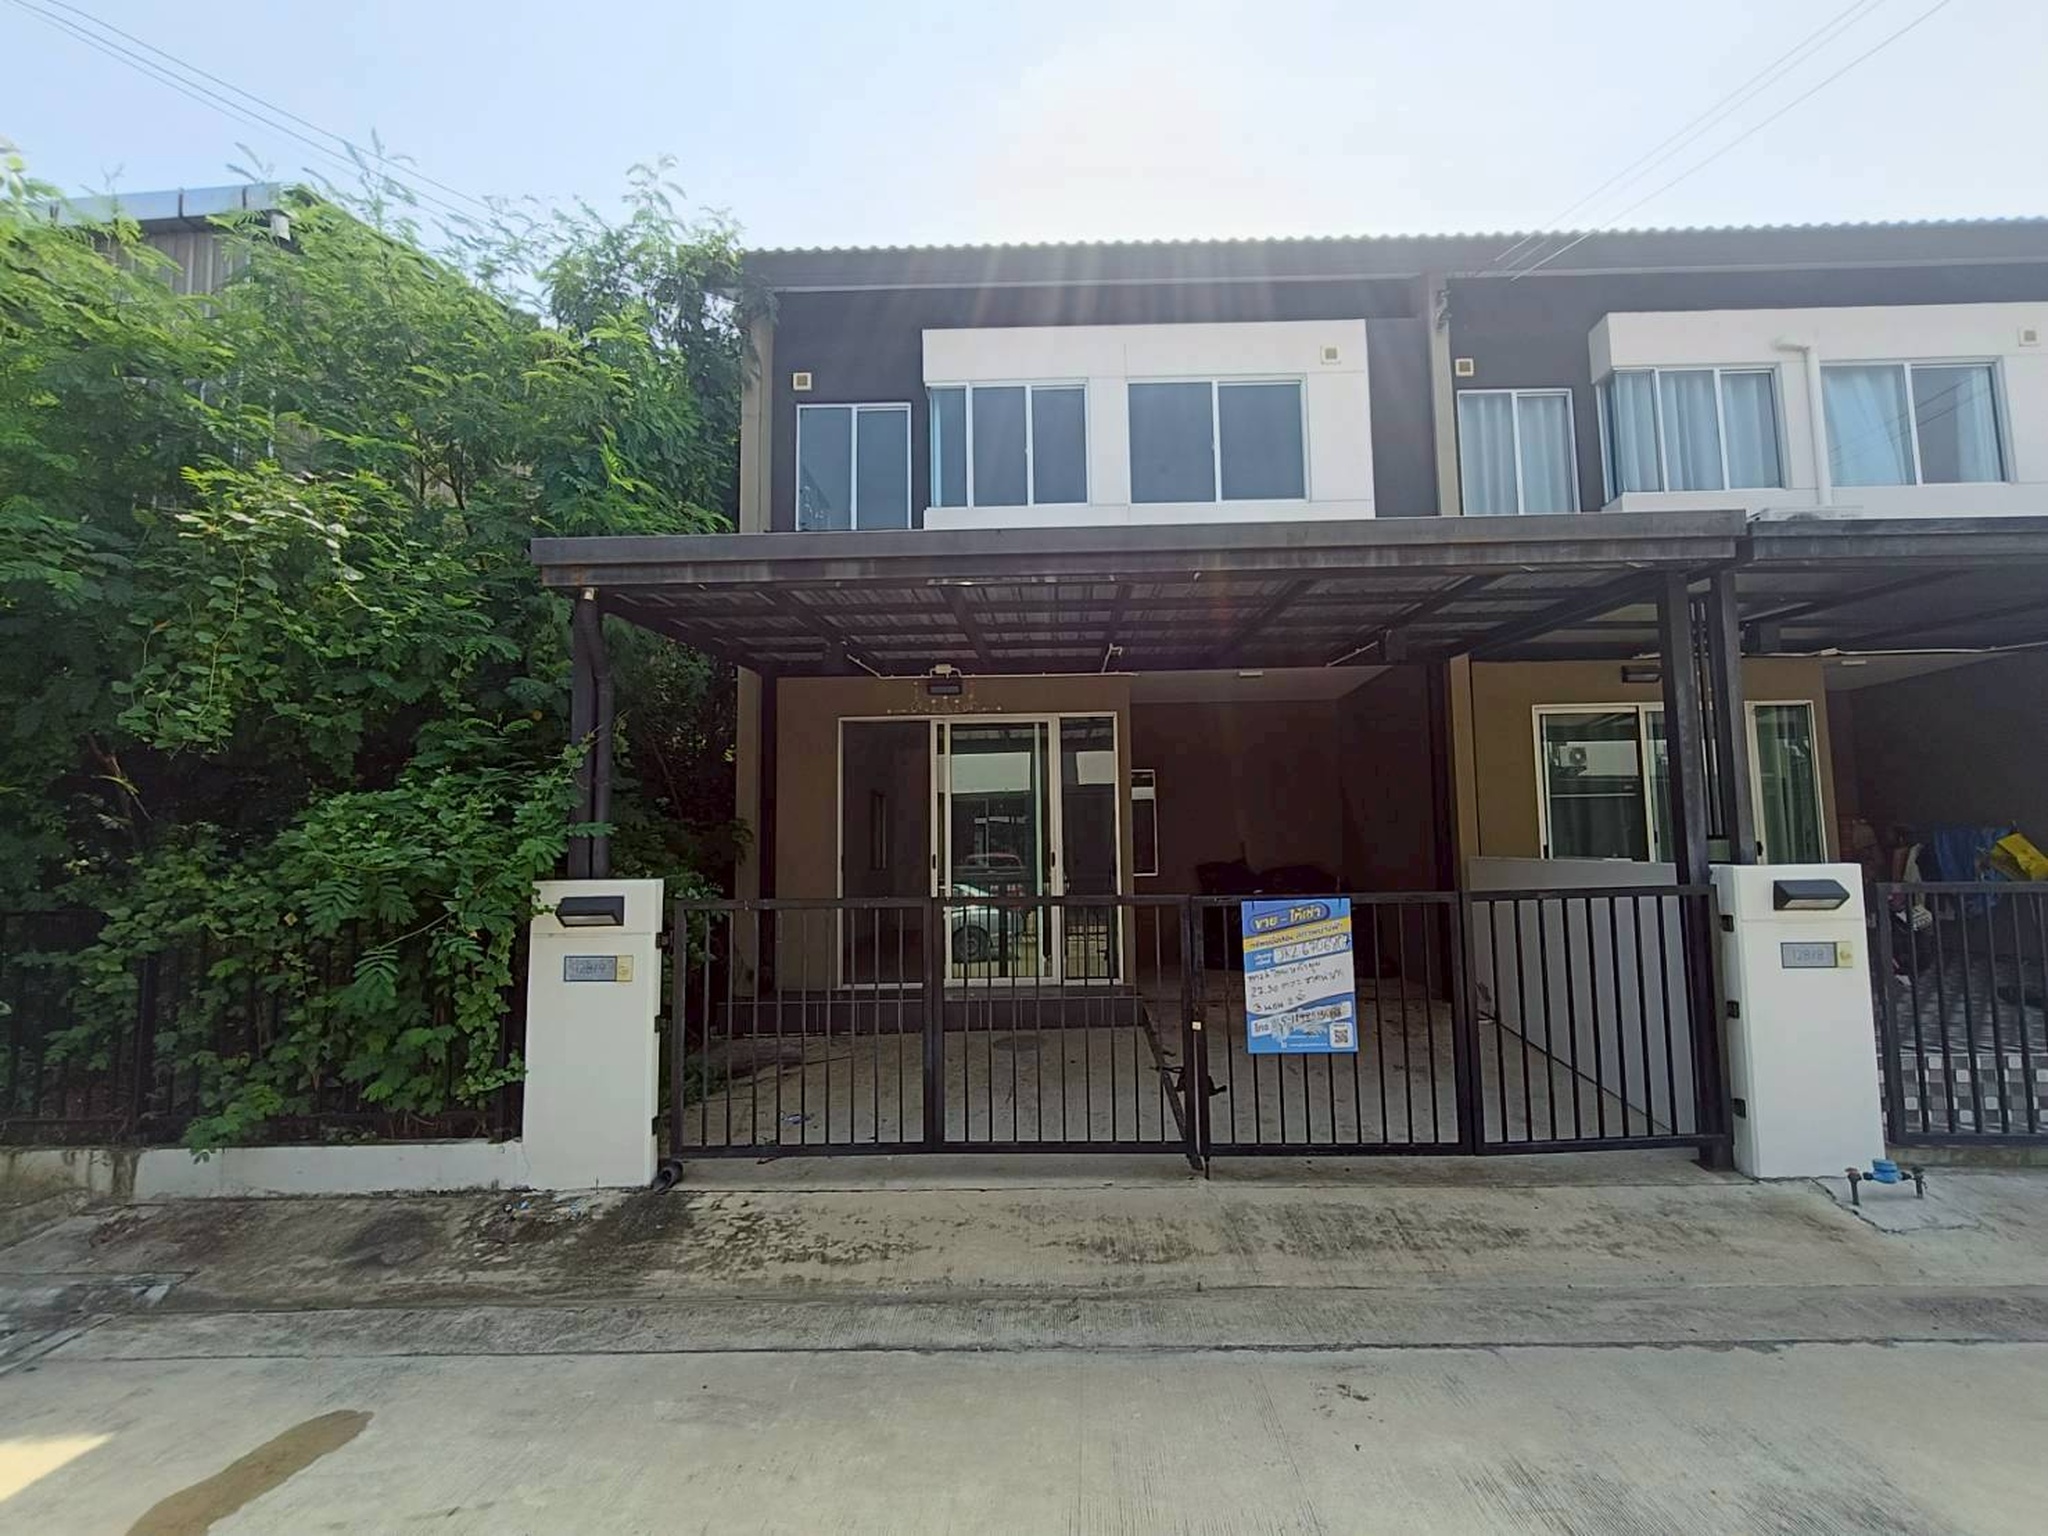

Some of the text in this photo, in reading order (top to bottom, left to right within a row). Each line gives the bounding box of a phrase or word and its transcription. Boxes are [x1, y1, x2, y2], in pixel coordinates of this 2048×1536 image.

[1254, 916, 1278, 930] ขาย
[1289, 906, 1322, 923] ให้เช่า
